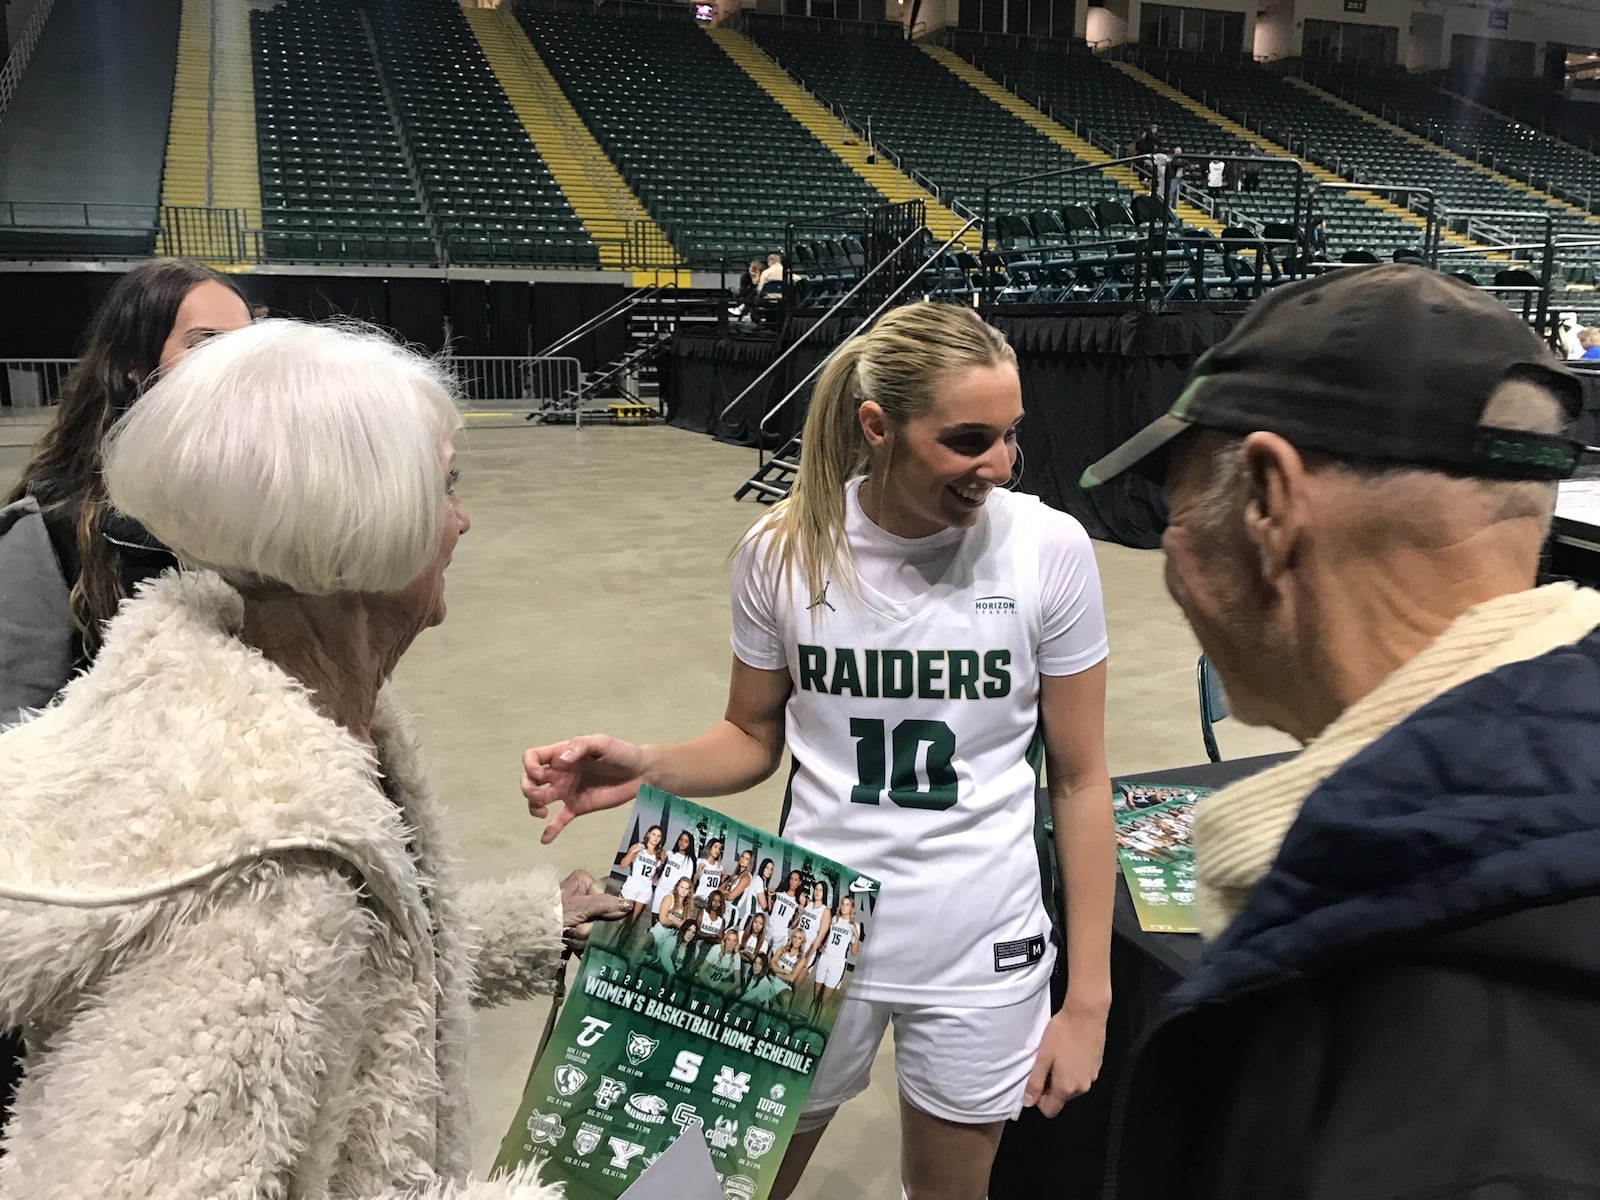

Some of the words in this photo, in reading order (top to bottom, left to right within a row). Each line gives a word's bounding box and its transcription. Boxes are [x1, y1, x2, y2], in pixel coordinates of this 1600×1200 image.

[975, 602, 1015, 610] HORIZON
[798, 644, 1011, 700] RAIDERS
[850, 717, 958, 811] 10
[641, 864, 652, 877] 12
[706, 877, 719, 888] 30
[778, 904, 787, 917] 11
[800, 916, 812, 930] 55
[831, 933, 841, 946] 15
[1032, 943, 1041, 956] M
[600, 966, 676, 1002] 2023-24
[690, 1000, 751, 1030] WRIGHT
[764, 1028, 809, 1053] STATE
[585, 976, 646, 1012] WOMEN'S
[644, 998, 720, 1040] BASKETBALL
[720, 1027, 755, 1053] HOME
[754, 1040, 812, 1074] SCHEDULE
[670, 1050, 704, 1083] S
[623, 1102, 666, 1125] MILWAUKEE
[757, 1097, 786, 1117] IUPUI
[608, 1136, 645, 1169] Y
